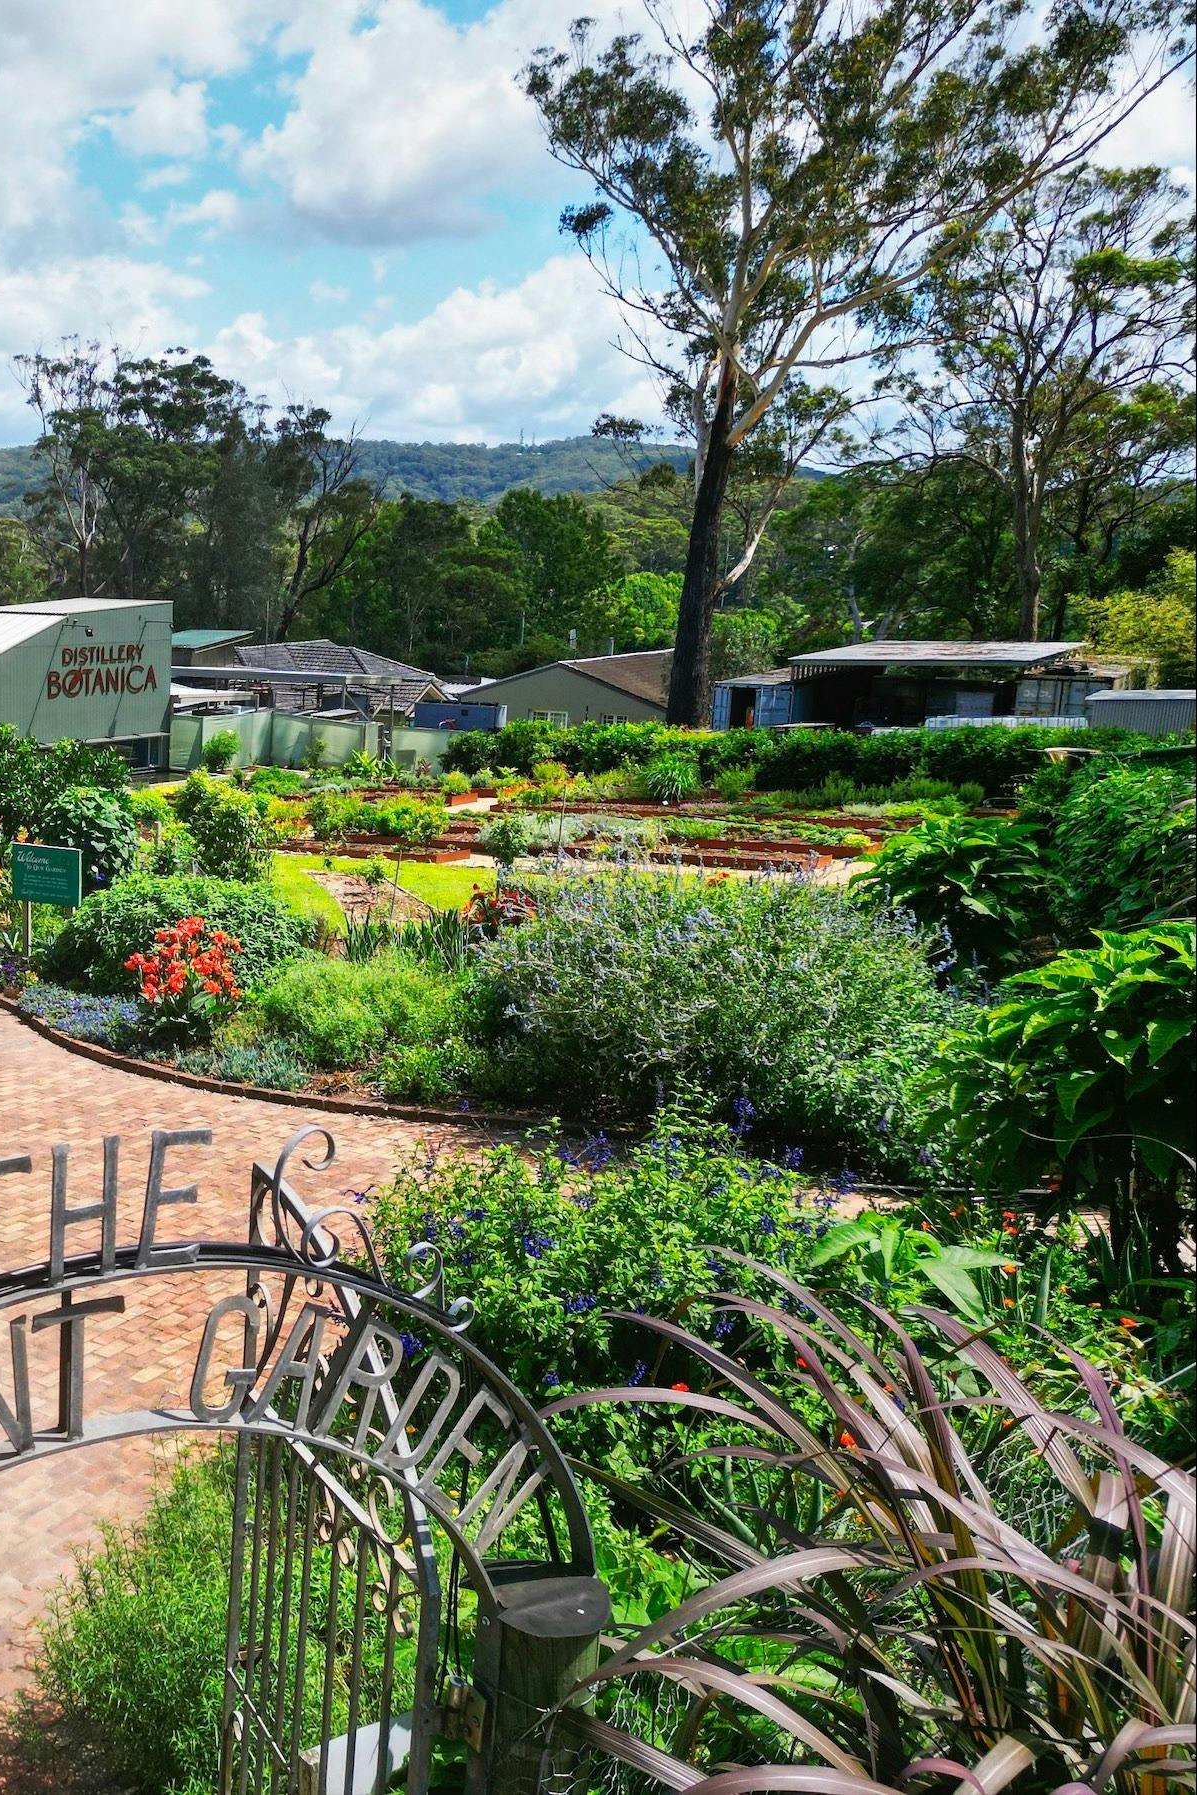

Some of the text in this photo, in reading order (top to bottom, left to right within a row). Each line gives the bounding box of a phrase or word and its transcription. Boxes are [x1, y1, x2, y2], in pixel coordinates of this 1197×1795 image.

[62, 644, 145, 667] DISTILLERY
[47, 665, 157, 700] BOTANICA
[191, 1296, 552, 1556] GARDEN
